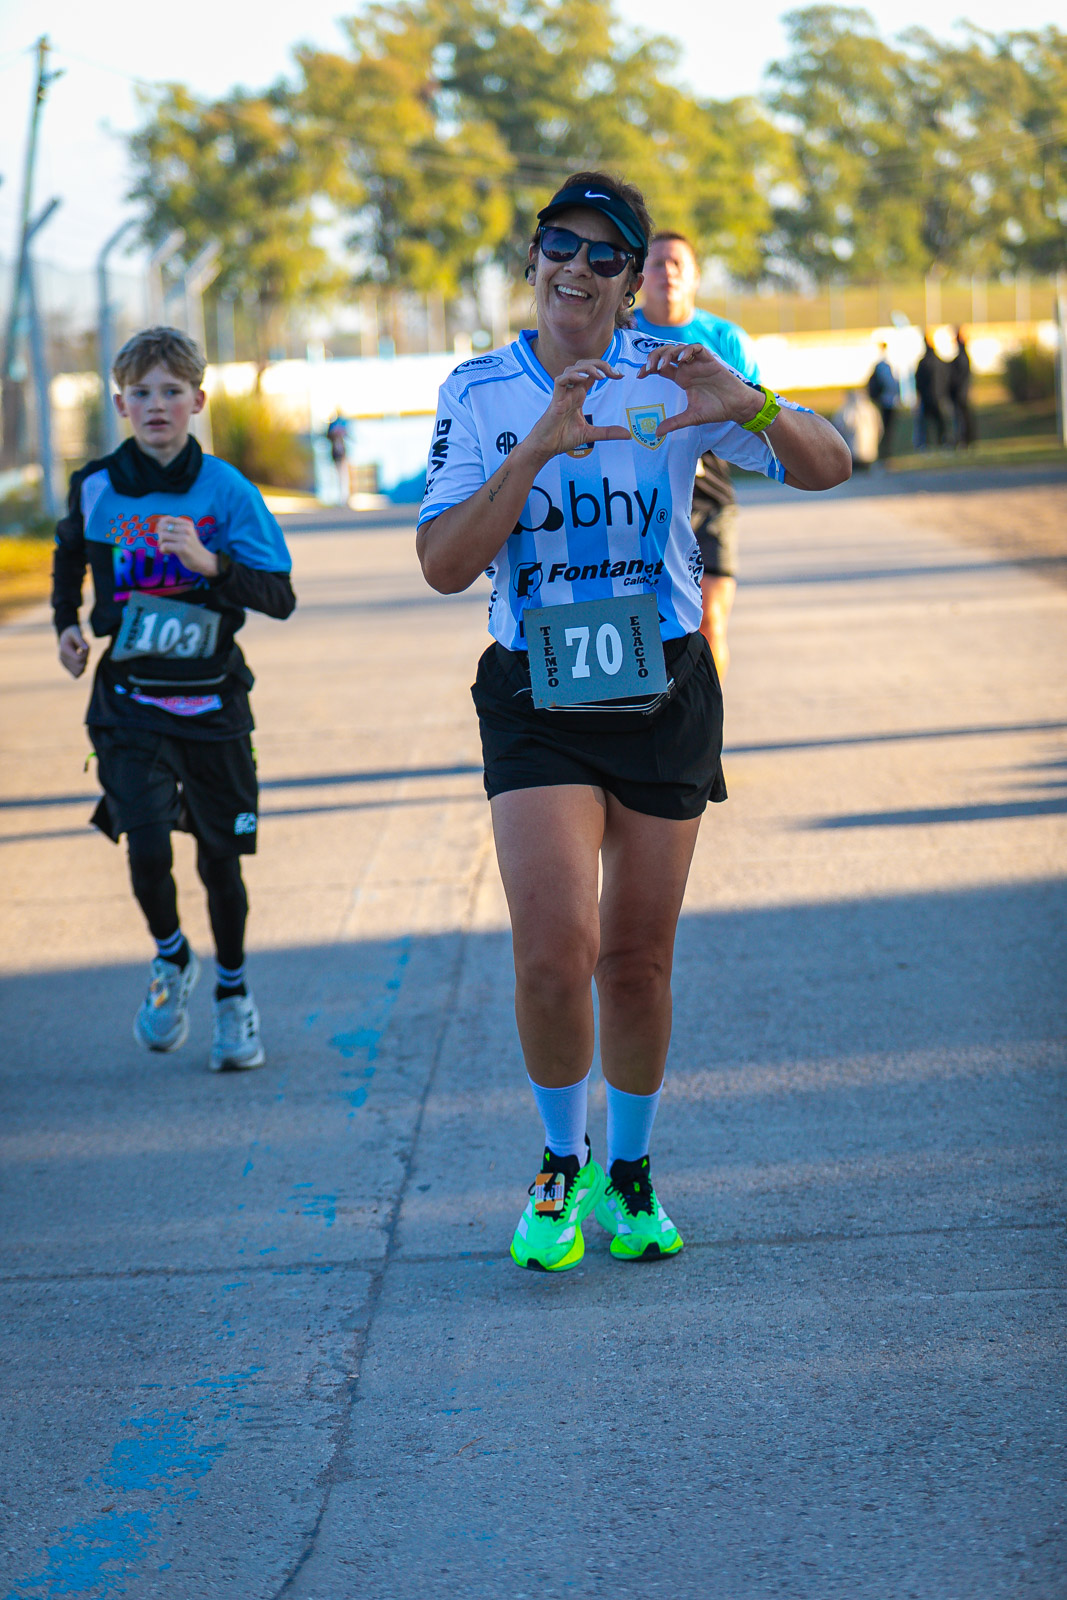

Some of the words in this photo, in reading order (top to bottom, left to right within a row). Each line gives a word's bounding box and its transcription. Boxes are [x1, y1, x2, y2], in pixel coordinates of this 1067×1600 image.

[431, 418, 453, 475] VMG
[568, 476, 658, 537] bhy
[135, 612, 201, 658] 103
[539, 625, 560, 688] TIEMPO
[564, 622, 624, 679] 70
[629, 615, 649, 679] EXACTO
